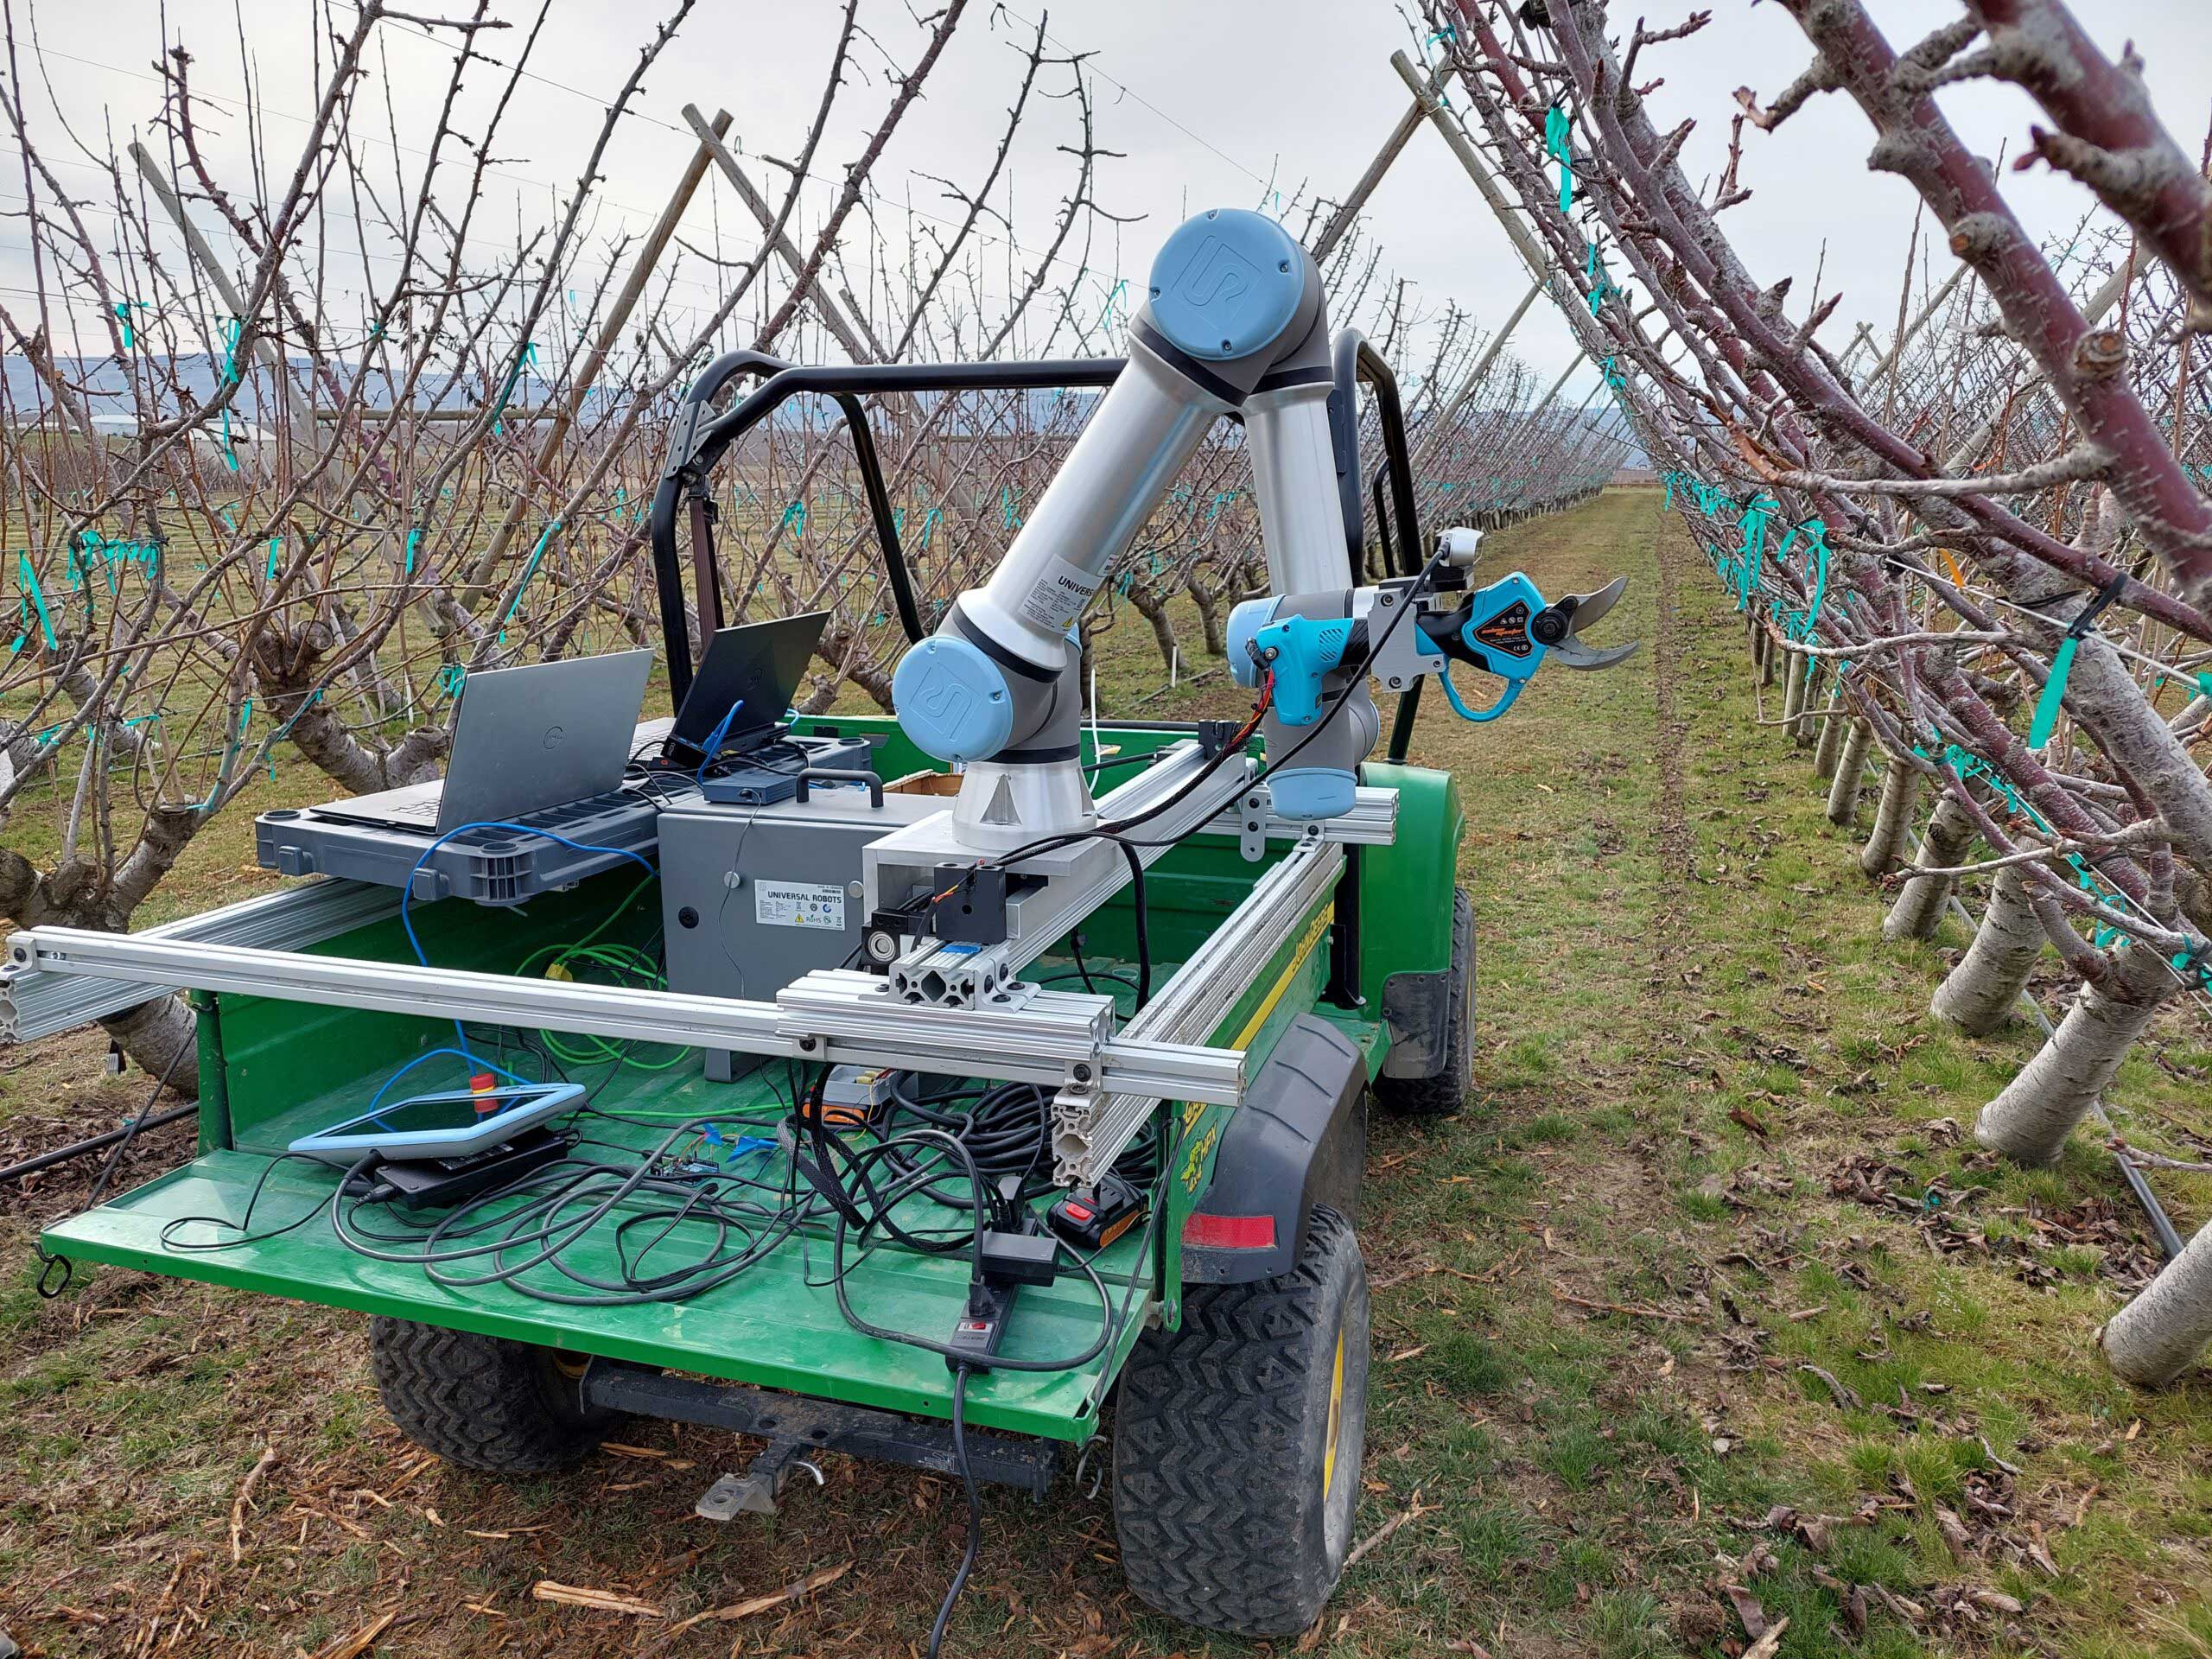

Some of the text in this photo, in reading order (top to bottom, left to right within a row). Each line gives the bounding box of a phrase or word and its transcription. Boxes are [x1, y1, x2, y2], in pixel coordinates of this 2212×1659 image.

[767, 891, 810, 901] UNIVERSAL
[812, 894, 842, 904] ROBOTS
[1200, 1121, 1218, 1162] HPX
